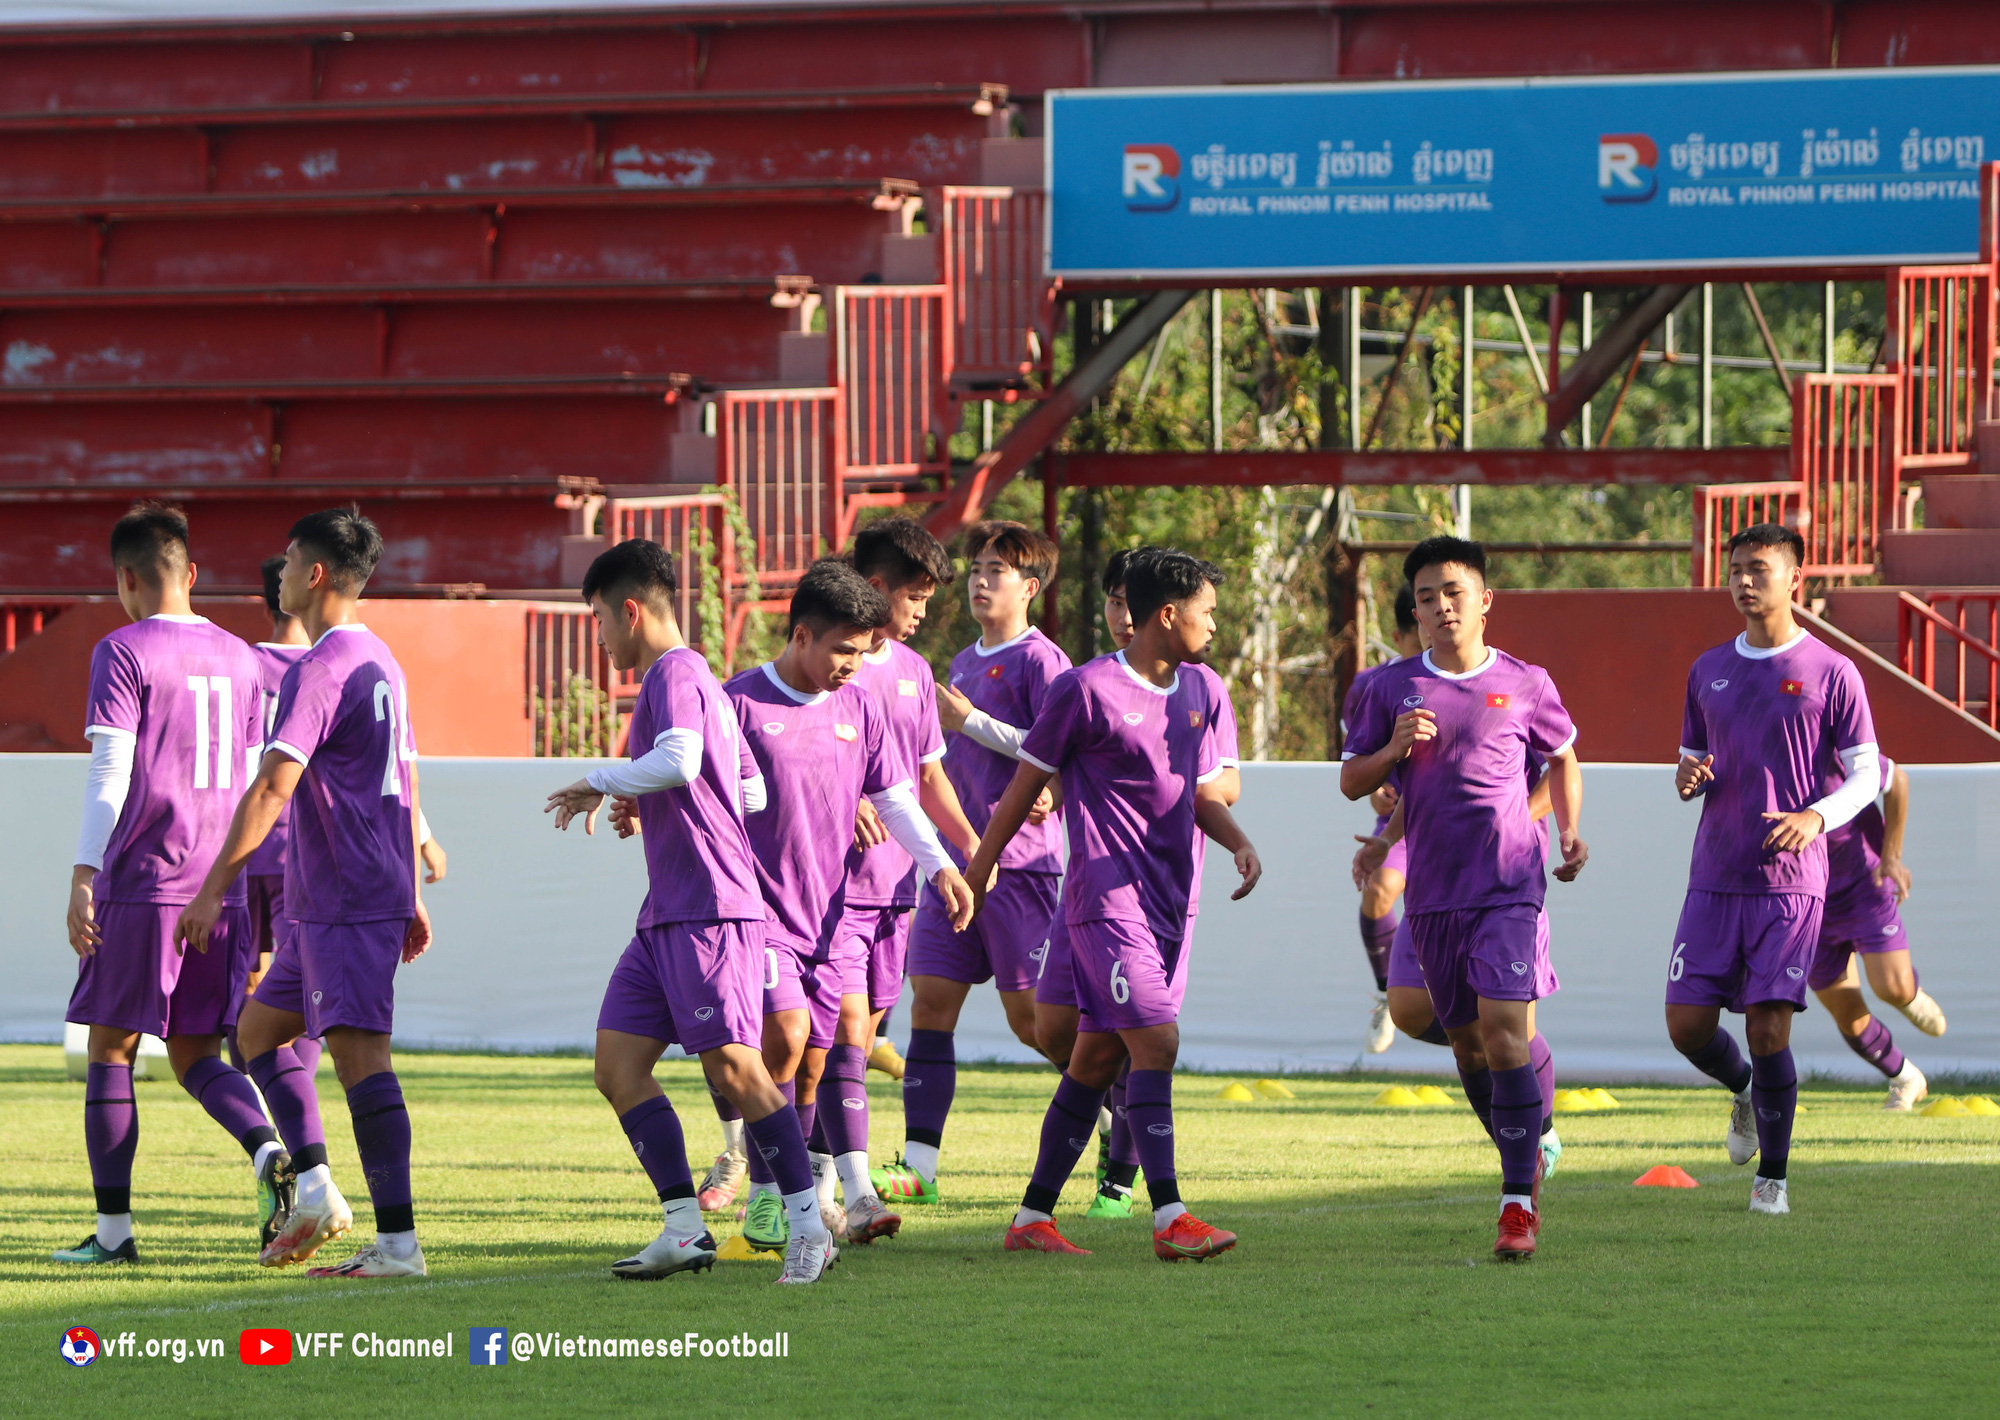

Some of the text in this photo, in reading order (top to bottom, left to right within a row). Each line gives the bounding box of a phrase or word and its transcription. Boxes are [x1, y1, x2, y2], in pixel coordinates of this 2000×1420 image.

[1190, 192, 1493, 215] ROYAL PHNOM PENH HOSPITAL
[1668, 180, 1980, 206] ROYAL PHNOM PENH HOSPITAL
[187, 675, 233, 789] 11
[1669, 942, 1687, 982] 6
[1110, 960, 1130, 1005] 6
